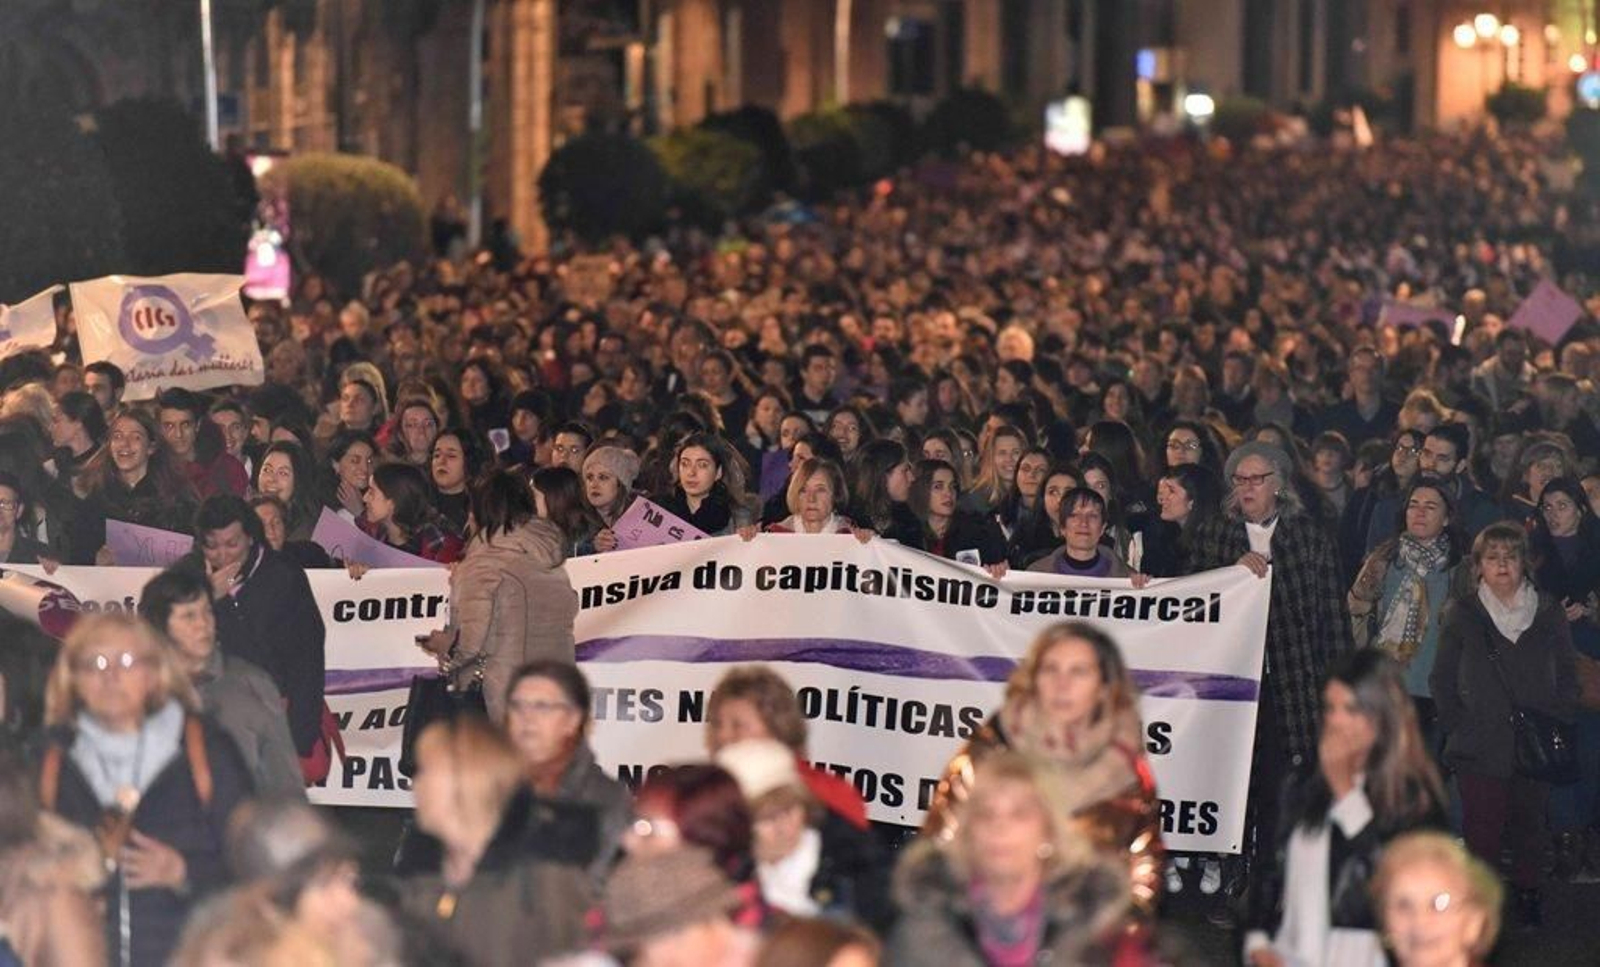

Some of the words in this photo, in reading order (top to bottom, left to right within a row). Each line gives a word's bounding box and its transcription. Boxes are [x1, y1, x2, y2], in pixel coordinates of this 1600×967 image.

[134, 306, 176, 331] CIG
[333, 592, 449, 622] contr
[693, 560, 743, 591] do
[755, 561, 1000, 609] capitalismo
[1010, 589, 1221, 623] patriarcal
[803, 760, 904, 807] TOS
